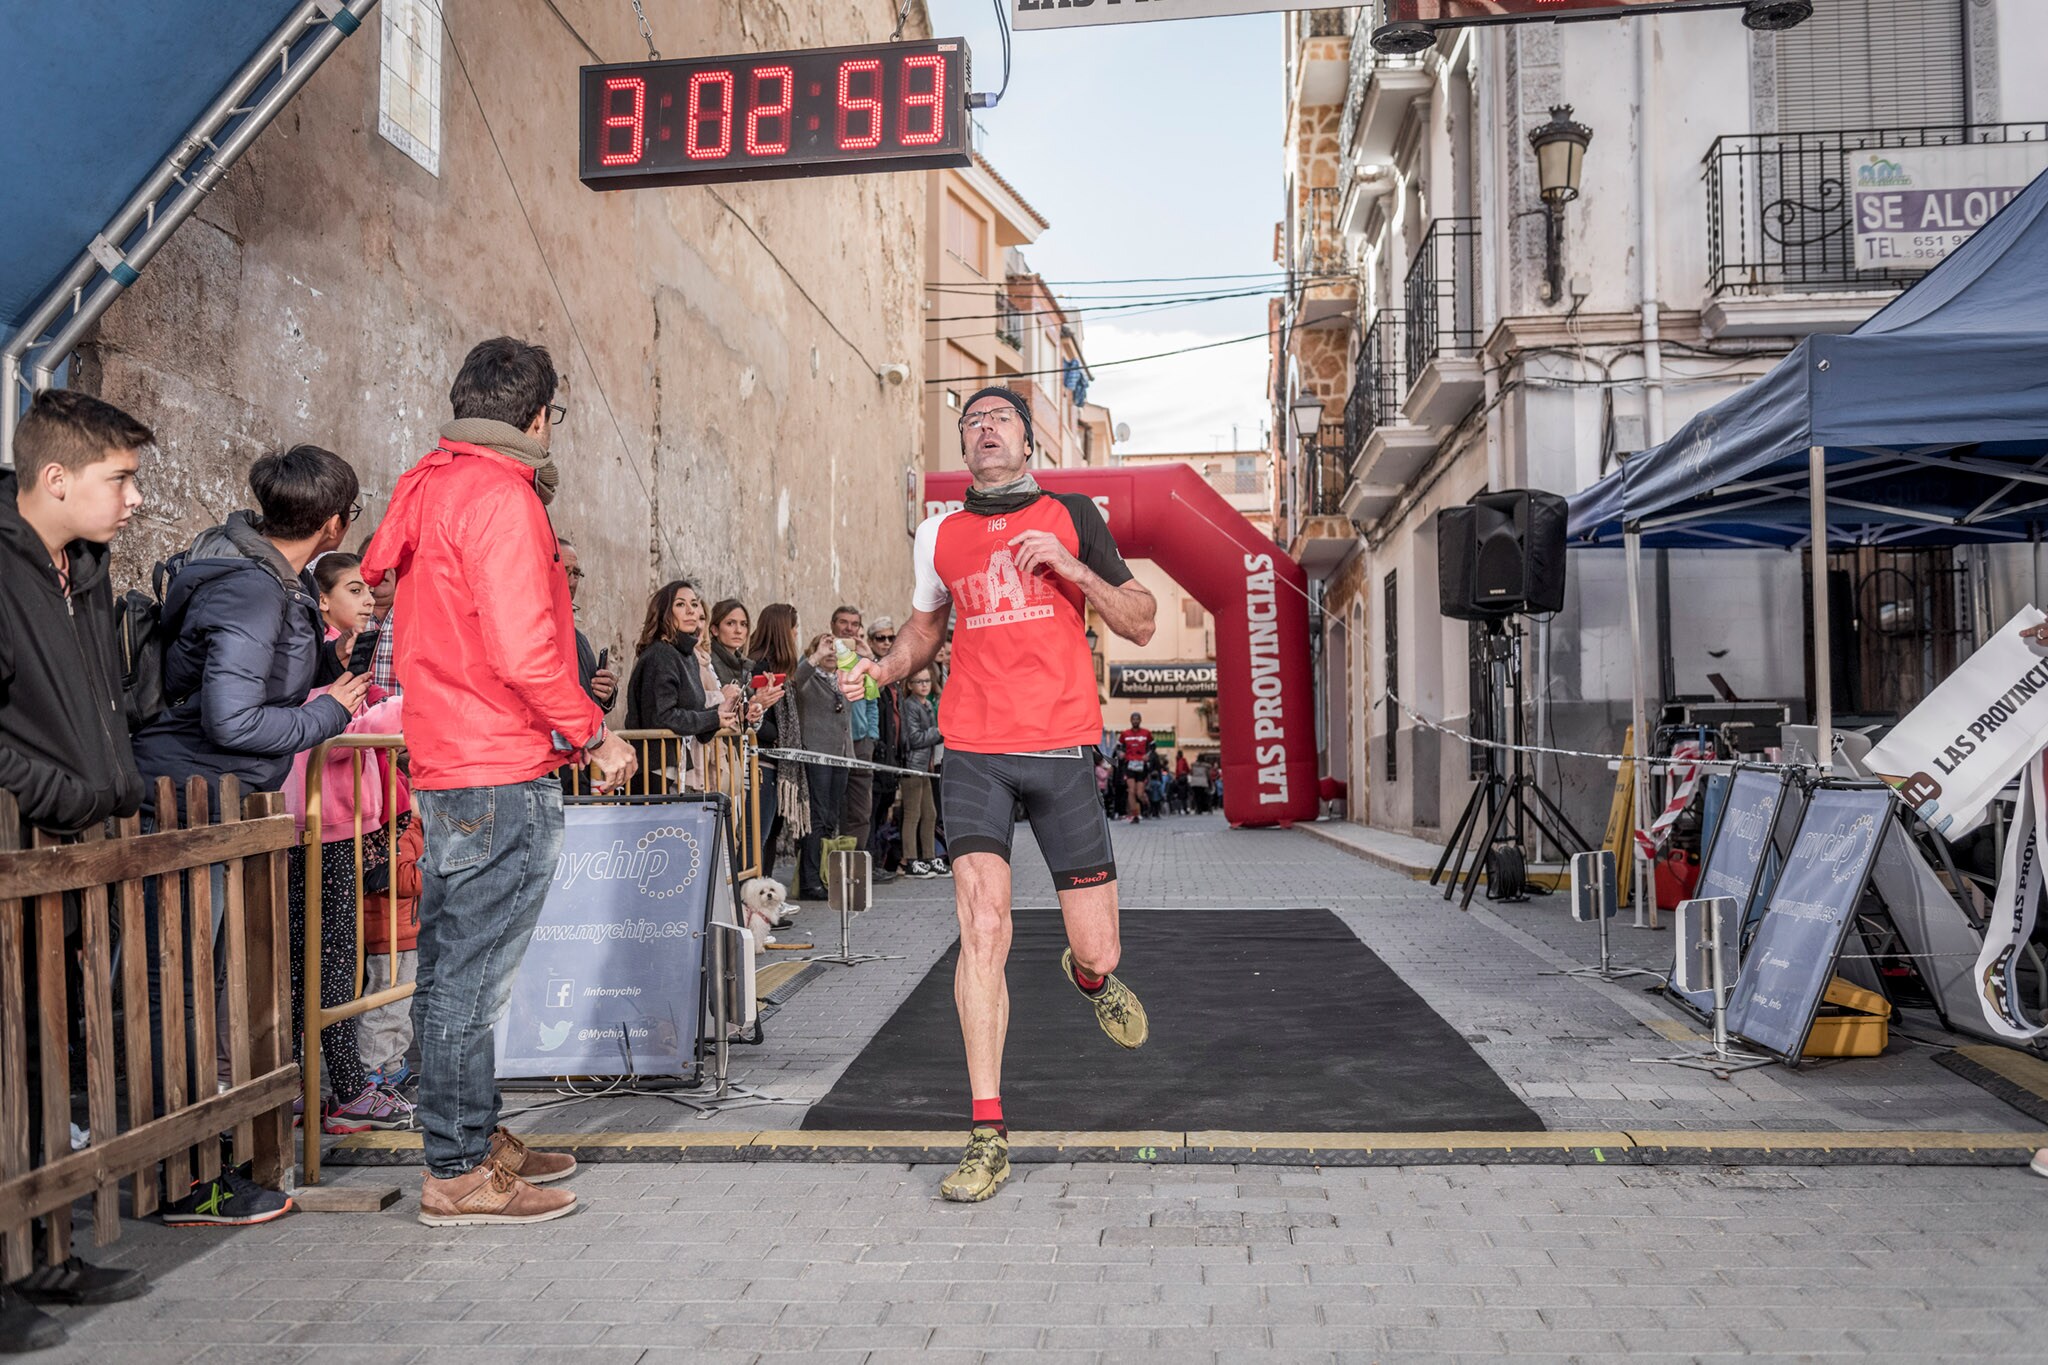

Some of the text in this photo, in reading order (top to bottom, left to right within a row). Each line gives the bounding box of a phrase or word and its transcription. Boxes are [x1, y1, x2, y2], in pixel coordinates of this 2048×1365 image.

[1863, 196, 1904, 229] SE
[1913, 235, 1944, 247] 651
[1000, 612, 1014, 622] de
[1023, 608, 1051, 619] tena
[1122, 668, 1218, 682] POWERADE
[1244, 553, 1289, 804] LAS PROVINCIAS
[1154, 684, 1174, 694] para
[1932, 734, 1977, 776] LAS
[2011, 895, 2024, 934] LAS
